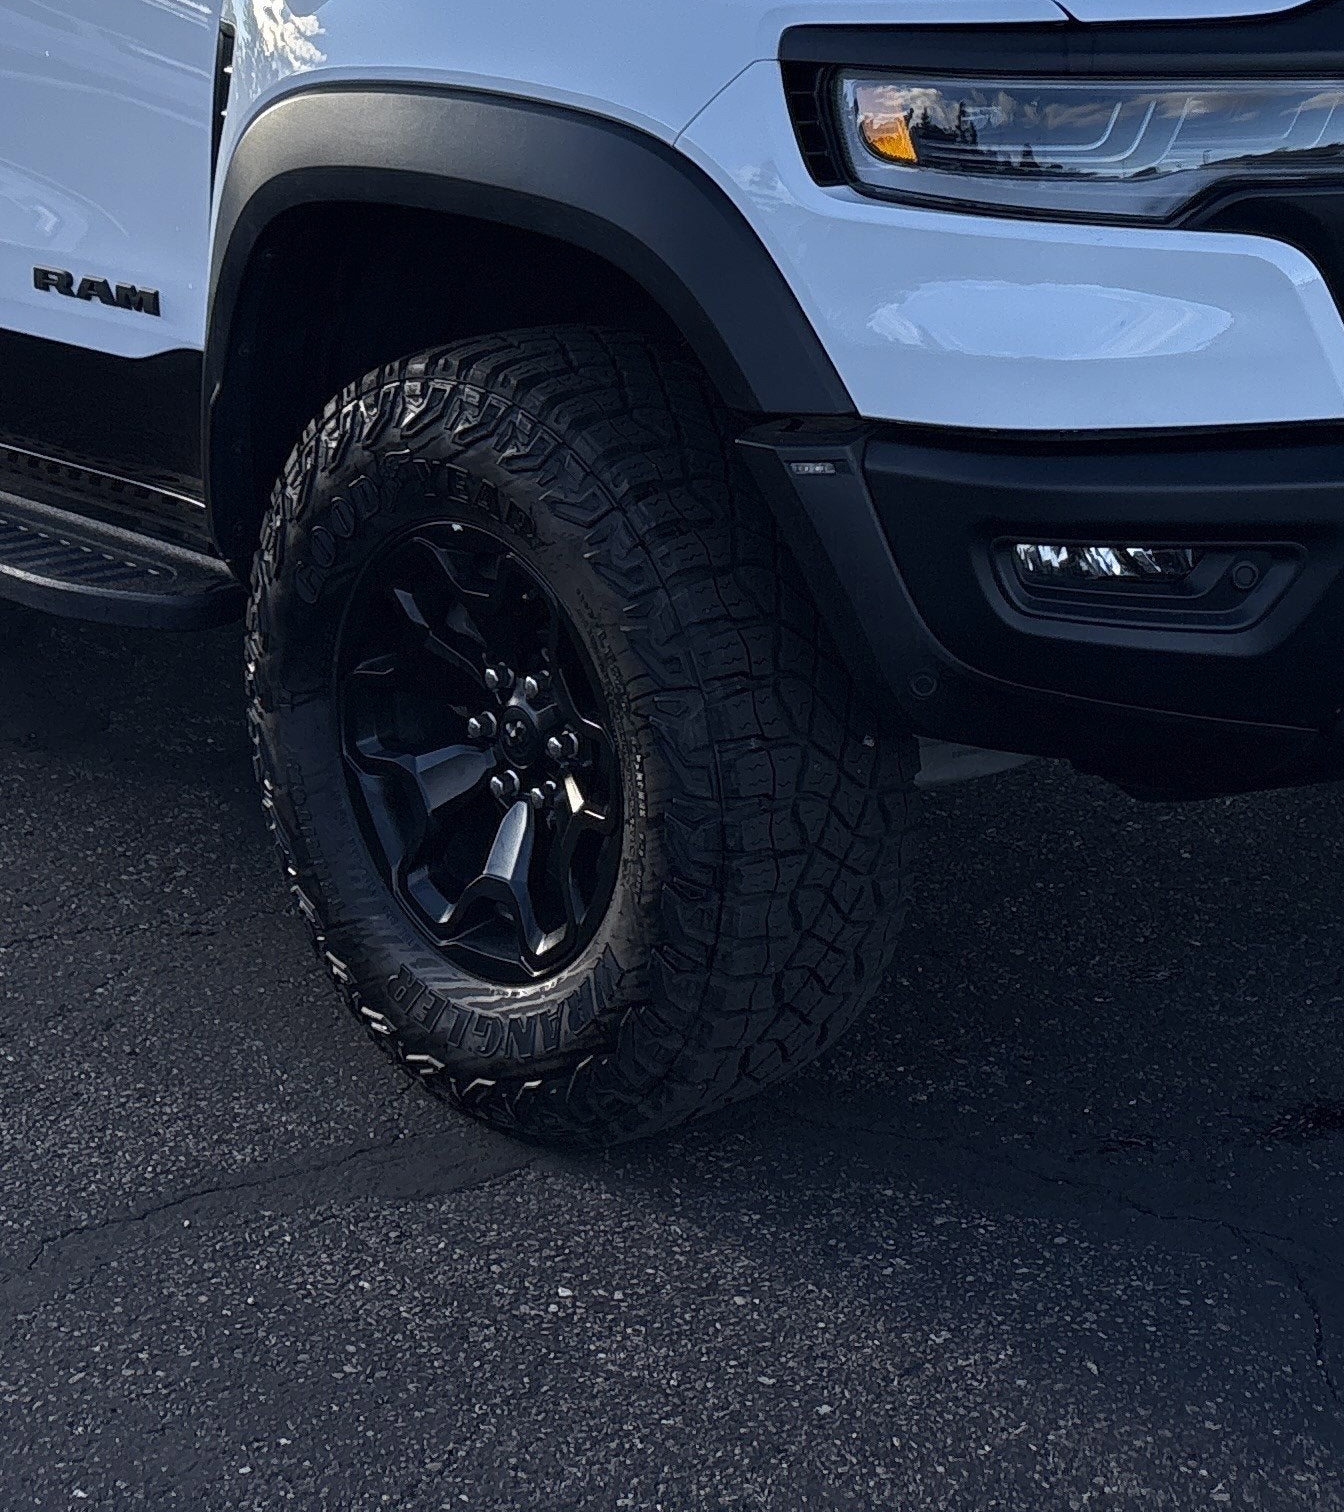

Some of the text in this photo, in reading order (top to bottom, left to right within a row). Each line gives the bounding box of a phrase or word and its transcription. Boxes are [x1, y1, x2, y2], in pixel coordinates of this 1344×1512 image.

[33, 265, 161, 317] RAM
[294, 458, 538, 605] GOODYEAR
[387, 942, 624, 1061] WRANGLER
